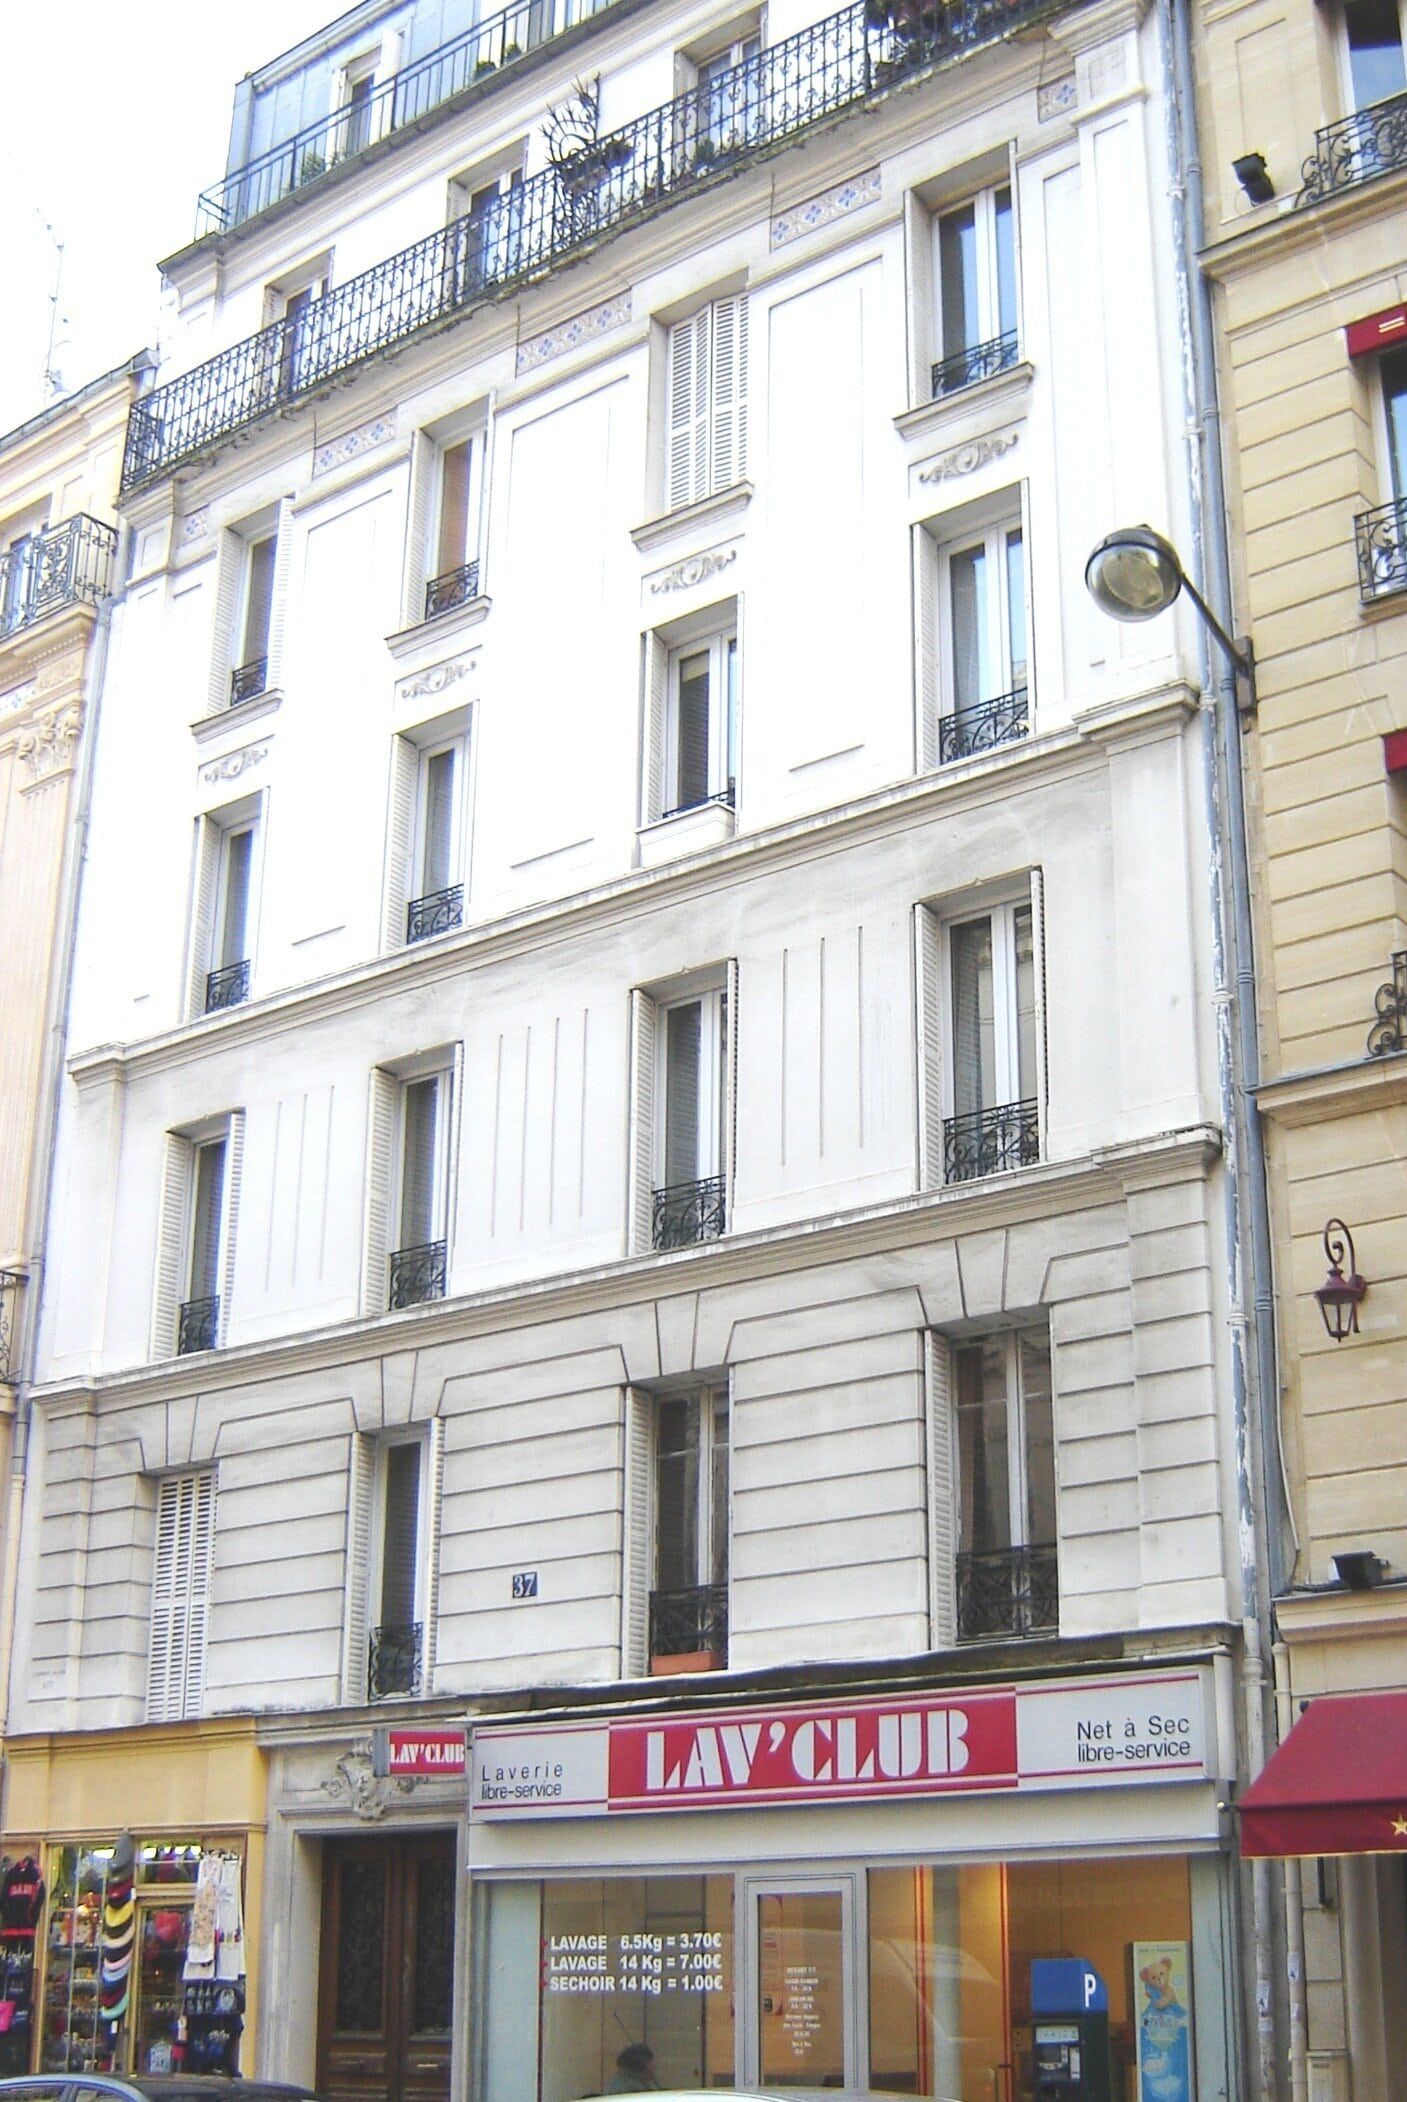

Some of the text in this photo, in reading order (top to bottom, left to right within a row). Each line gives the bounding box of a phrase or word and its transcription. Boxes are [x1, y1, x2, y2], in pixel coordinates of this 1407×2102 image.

[514, 1574, 535, 1597] 37
[1077, 1719, 1112, 1741] Net
[1148, 1715, 1190, 1736] Sec
[390, 1743, 465, 1764] LAV'CLUB
[647, 1709, 970, 1790] LAV'CLUB
[1078, 1738, 1191, 1762] libre-service
[482, 1761, 563, 1782] Laverie
[481, 1780, 562, 1800] libre-service
[551, 1935, 607, 1951] LAVAGE
[620, 1934, 662, 1952] 6.5Kg
[680, 1932, 722, 1949] 3.70€
[551, 1955, 607, 1971] LAVAGE
[620, 1955, 638, 1970] 14
[642, 1954, 662, 1973] Kg
[680, 1954, 722, 1970] 7.00€
[550, 1976, 615, 1991] SECHOIR
[619, 1976, 637, 1991] 14
[641, 1976, 662, 1994] Kg
[681, 1975, 723, 1991] 1.00€
[1084, 1973, 1097, 2008] P
